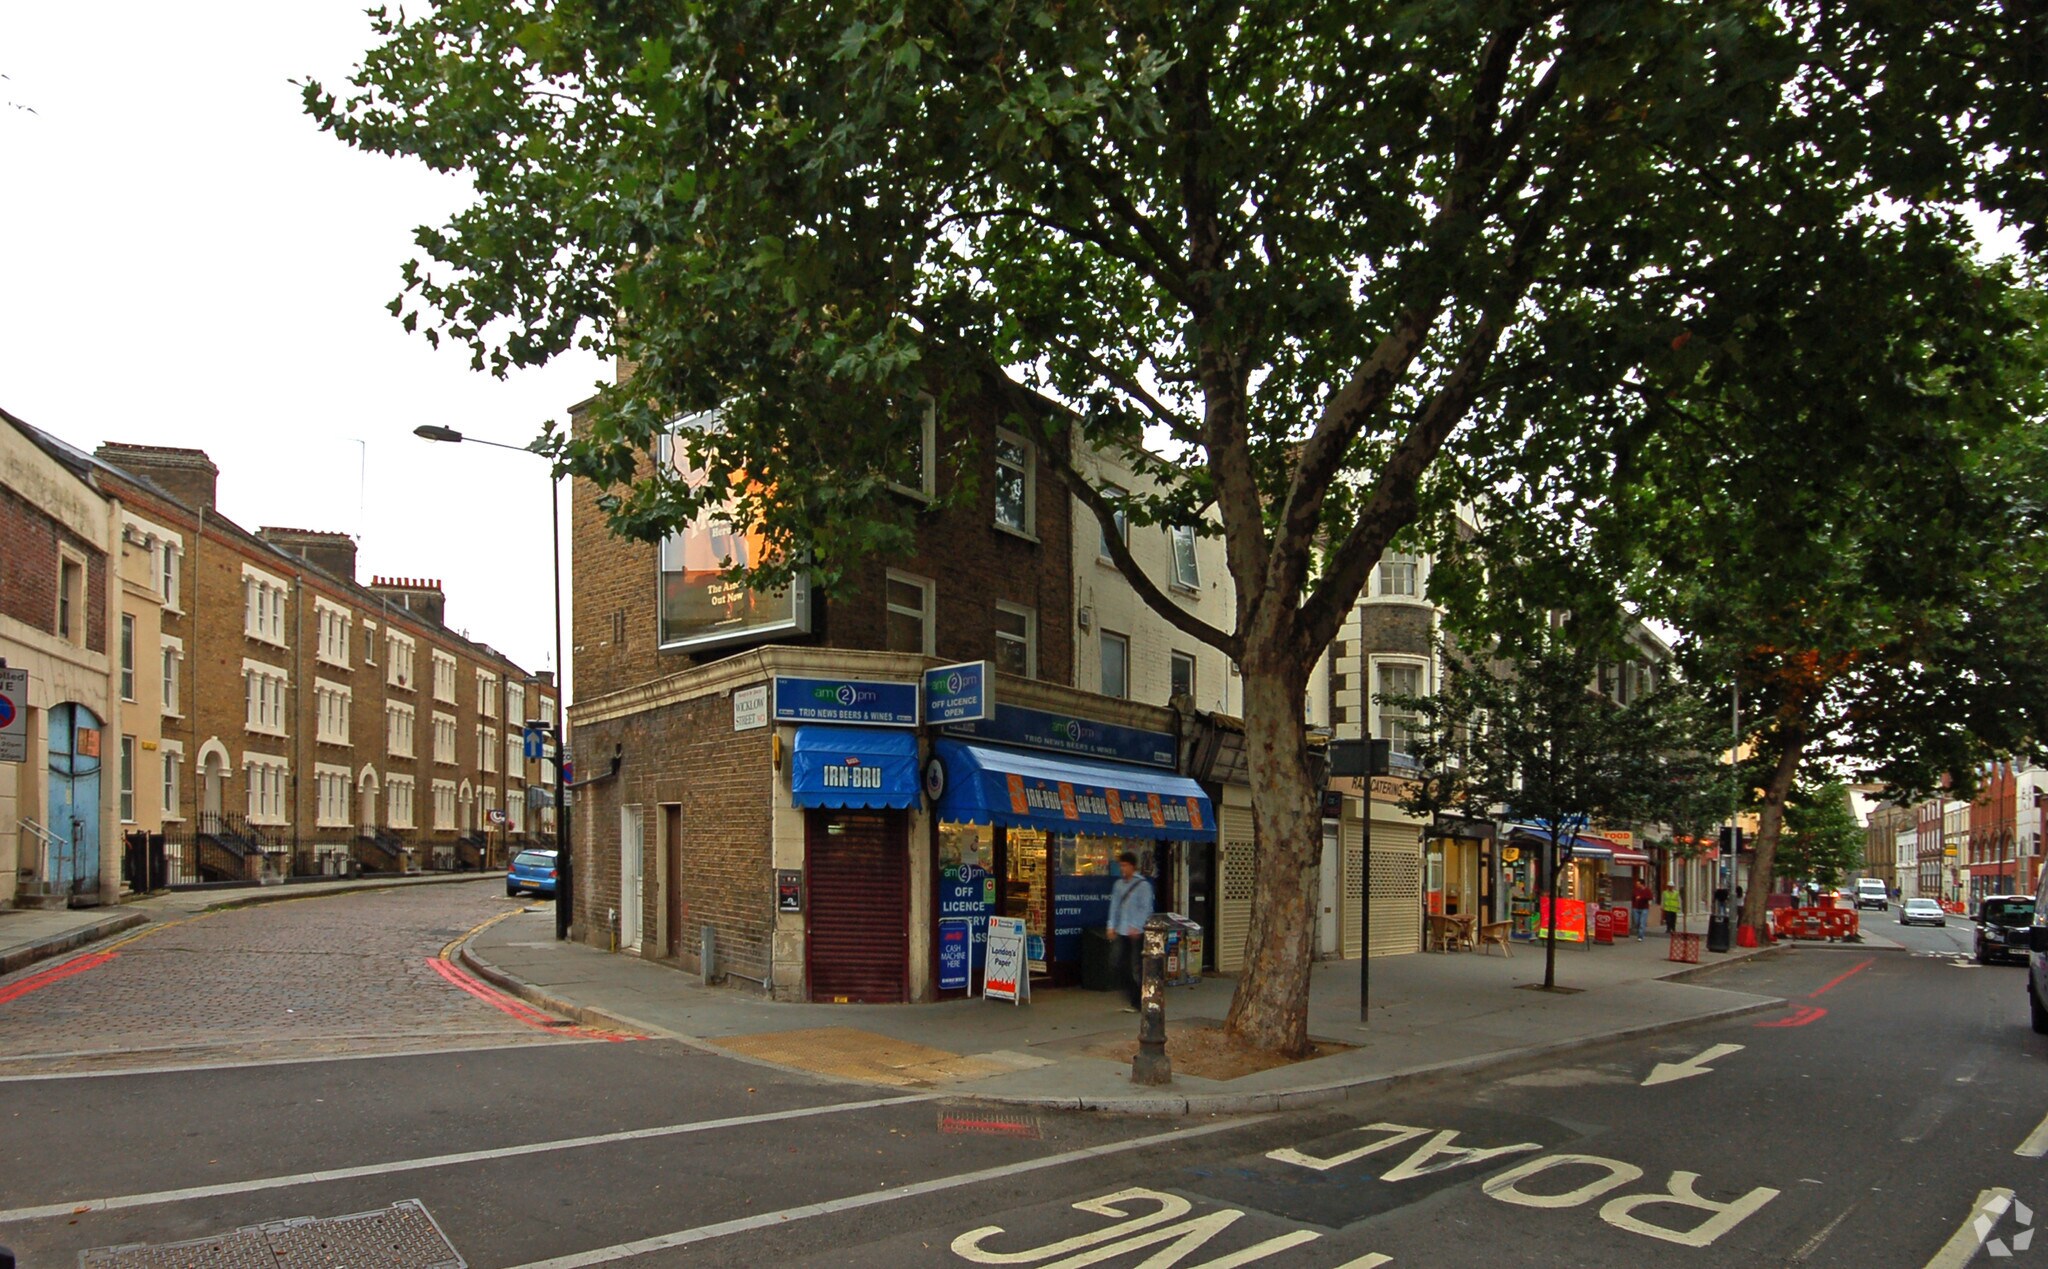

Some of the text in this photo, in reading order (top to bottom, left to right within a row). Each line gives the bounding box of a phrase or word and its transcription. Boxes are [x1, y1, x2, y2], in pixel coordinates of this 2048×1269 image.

[707, 584, 721, 595] The
[711, 592, 743, 606] Out Now
[735, 697, 765, 711] WICKLOW
[931, 696, 977, 709] OFF LICENCE
[799, 708, 816, 717] TRIO
[817, 709, 838, 718] NEWS
[839, 710, 861, 720] BEERS
[863, 711, 869, 720] &
[870, 712, 893, 721] WINES
[944, 708, 964, 717] OPEN
[736, 713, 756, 725] STREET
[1024, 734, 1042, 743] TRIO
[1044, 738, 1064, 747] NEWS
[1096, 746, 1117, 755] WINES
[954, 887, 974, 897] OFF
[943, 901, 985, 912] LICENCE
[1055, 907, 1081, 915] LOTTERY
[1055, 927, 1082, 935] CONFECT
[945, 944, 961, 953] CASH
[941, 952, 966, 960] MACHINE
[947, 960, 961, 968] HERE
[994, 958, 1011, 968] Paper
